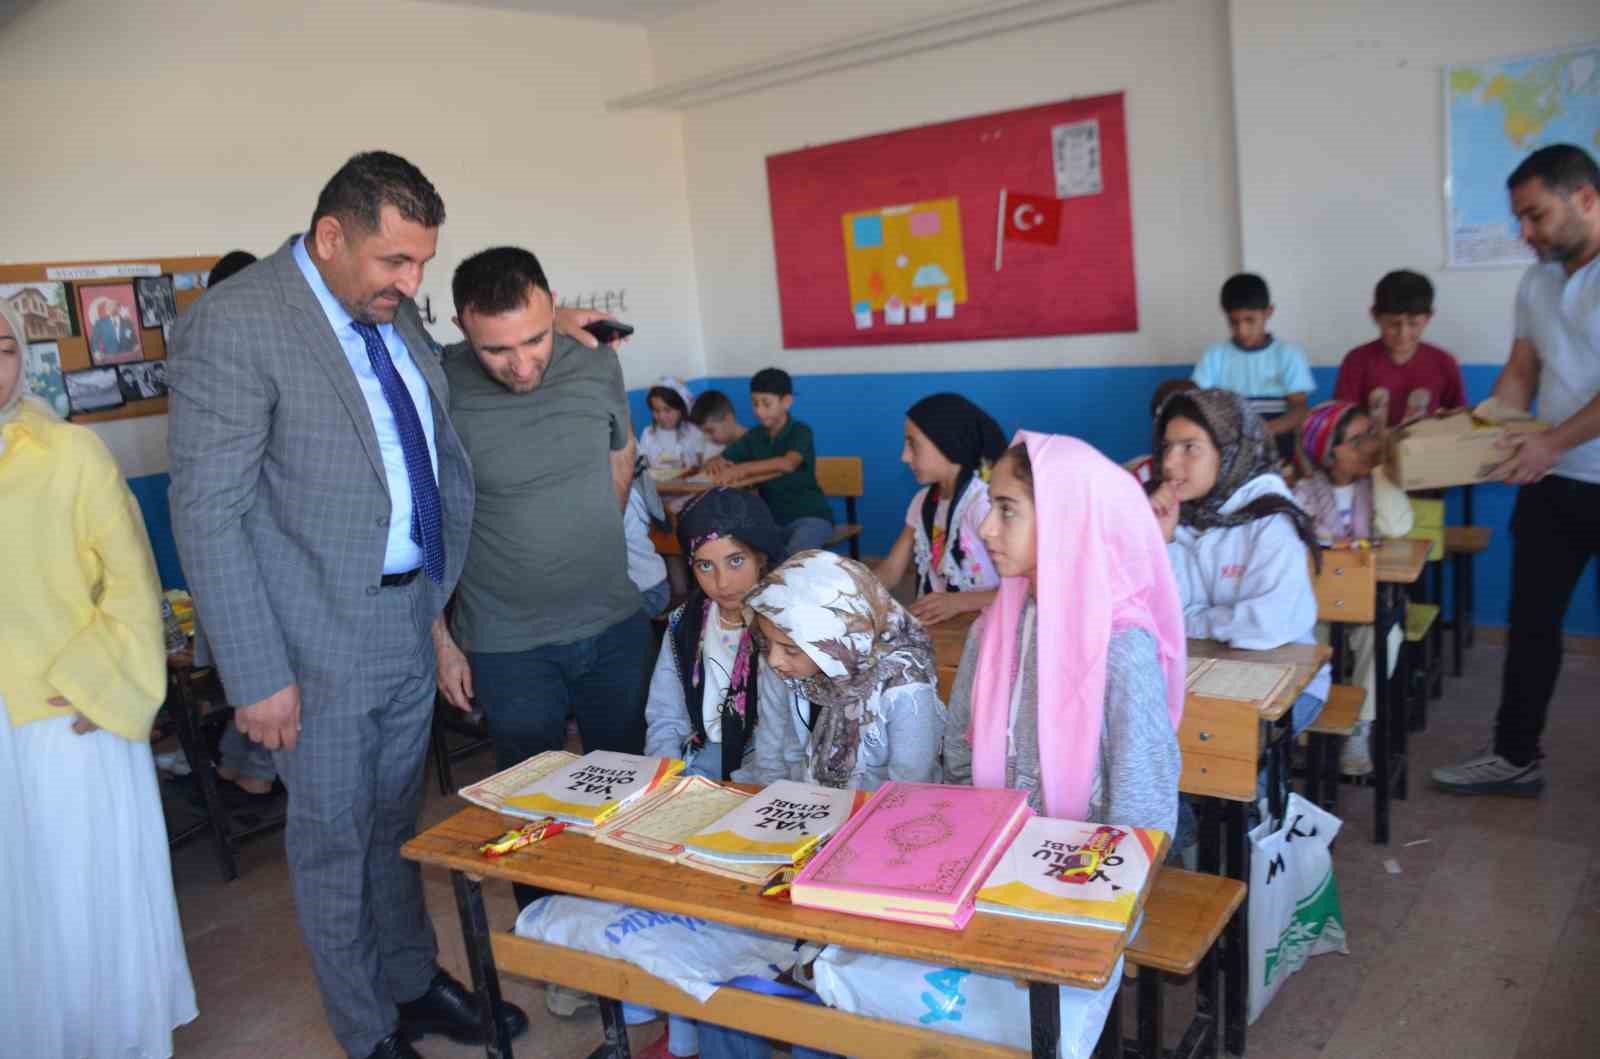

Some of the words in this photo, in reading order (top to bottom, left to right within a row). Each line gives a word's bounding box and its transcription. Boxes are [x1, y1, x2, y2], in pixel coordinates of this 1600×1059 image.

[569, 771, 634, 784] OKULU
[566, 781, 613, 794] YAZ
[755, 807, 830, 820] OKULU
[754, 818, 808, 832] YAZ
[1043, 864, 1111, 883] YZ
